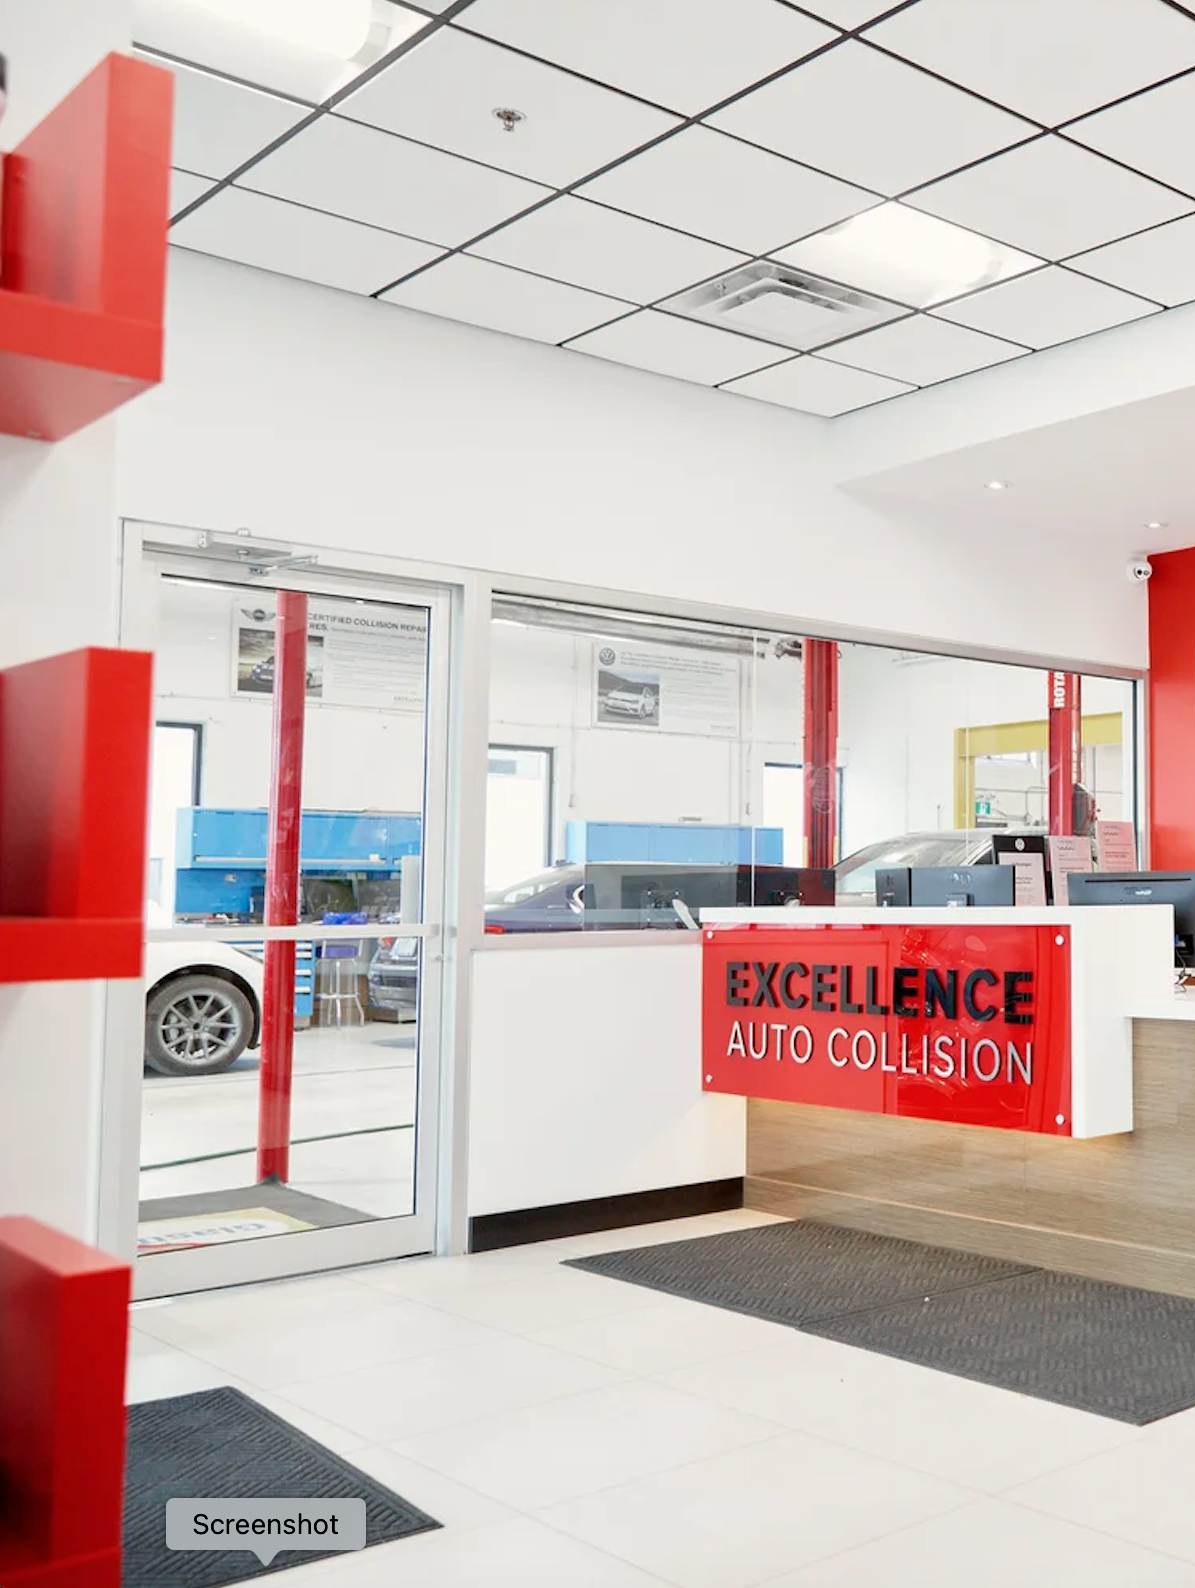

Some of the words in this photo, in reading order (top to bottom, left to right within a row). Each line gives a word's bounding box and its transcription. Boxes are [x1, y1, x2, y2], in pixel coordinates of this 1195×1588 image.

[354, 618, 399, 630] COLLISION
[725, 961, 1034, 1026] EXCELLENCE
[726, 1020, 814, 1065] AUTO
[827, 1027, 1034, 1086] COLLISION
